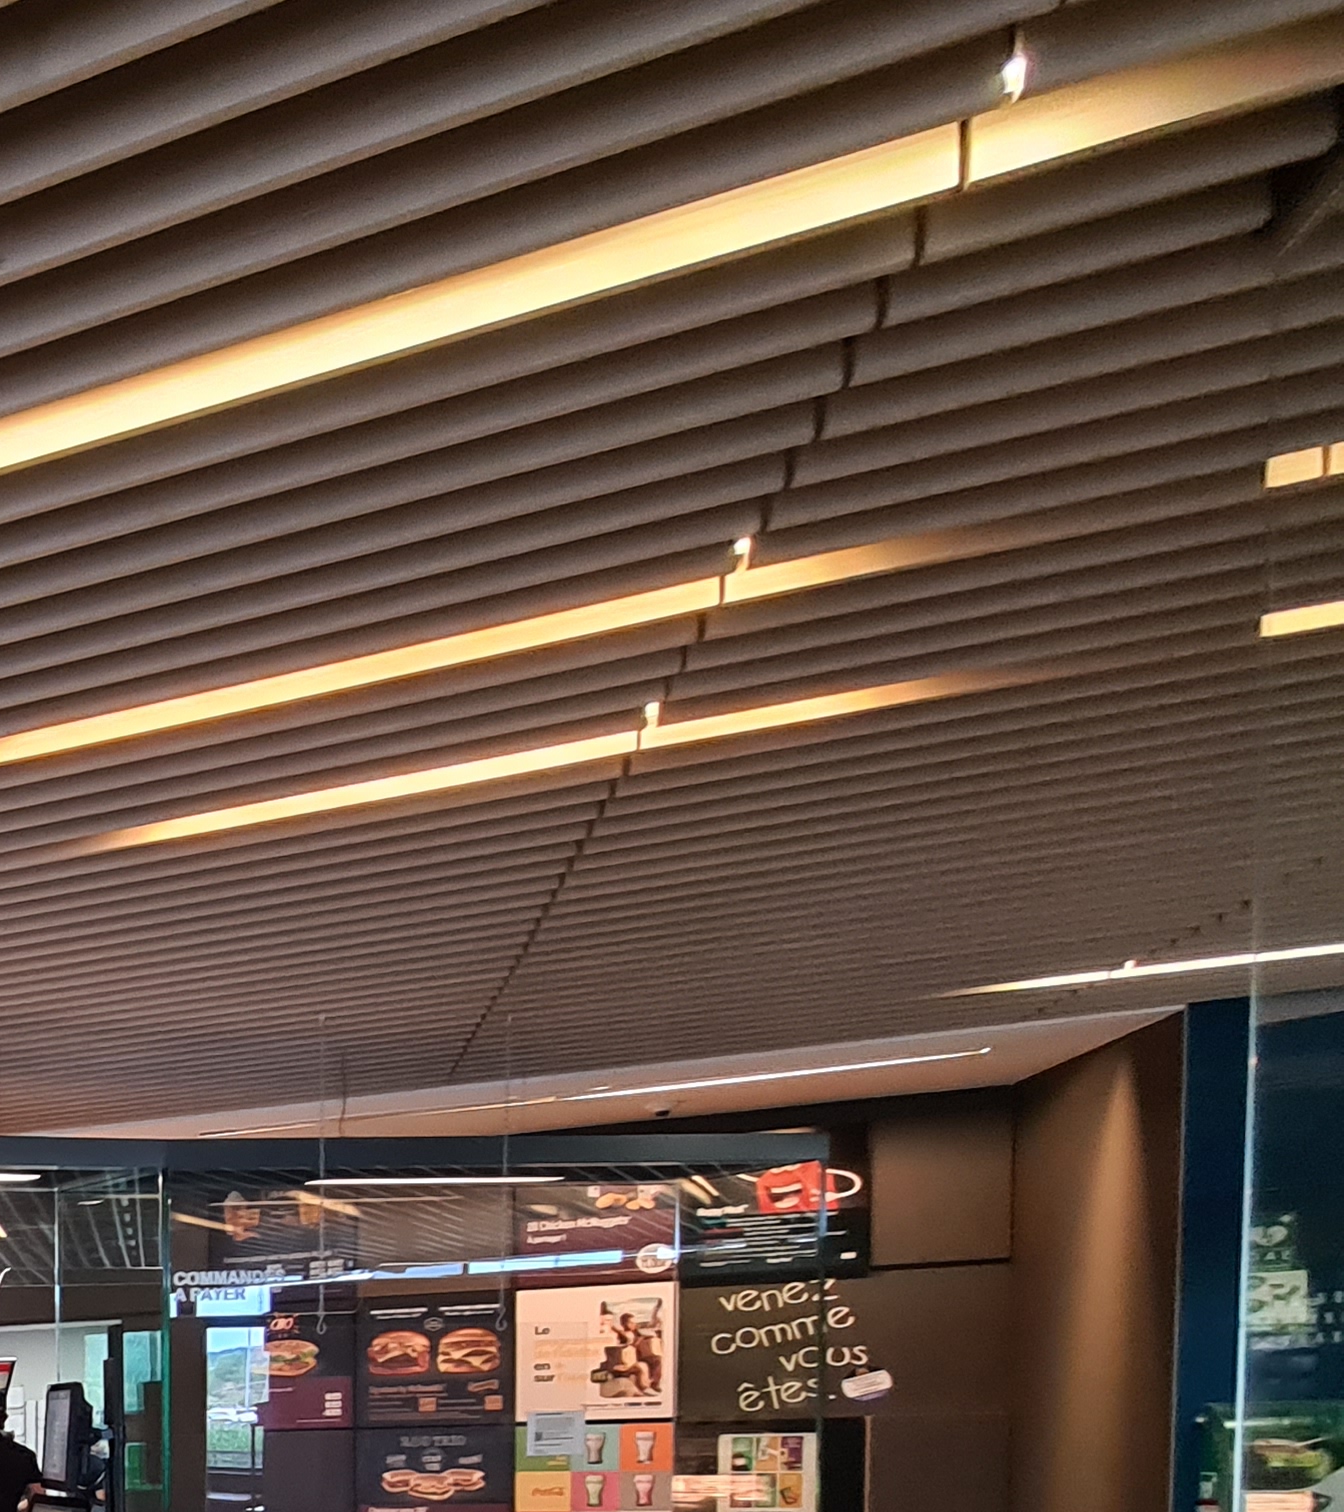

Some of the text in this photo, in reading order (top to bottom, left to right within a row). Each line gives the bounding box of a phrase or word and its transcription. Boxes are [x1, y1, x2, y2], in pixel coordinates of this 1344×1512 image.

[173, 1268, 287, 1287] COMMANDES
[189, 1287, 246, 1302] PAYER
[719, 1278, 840, 1311] venez
[534, 1326, 550, 1335] Le
[711, 1306, 855, 1354] comme
[779, 1345, 869, 1372] vous
